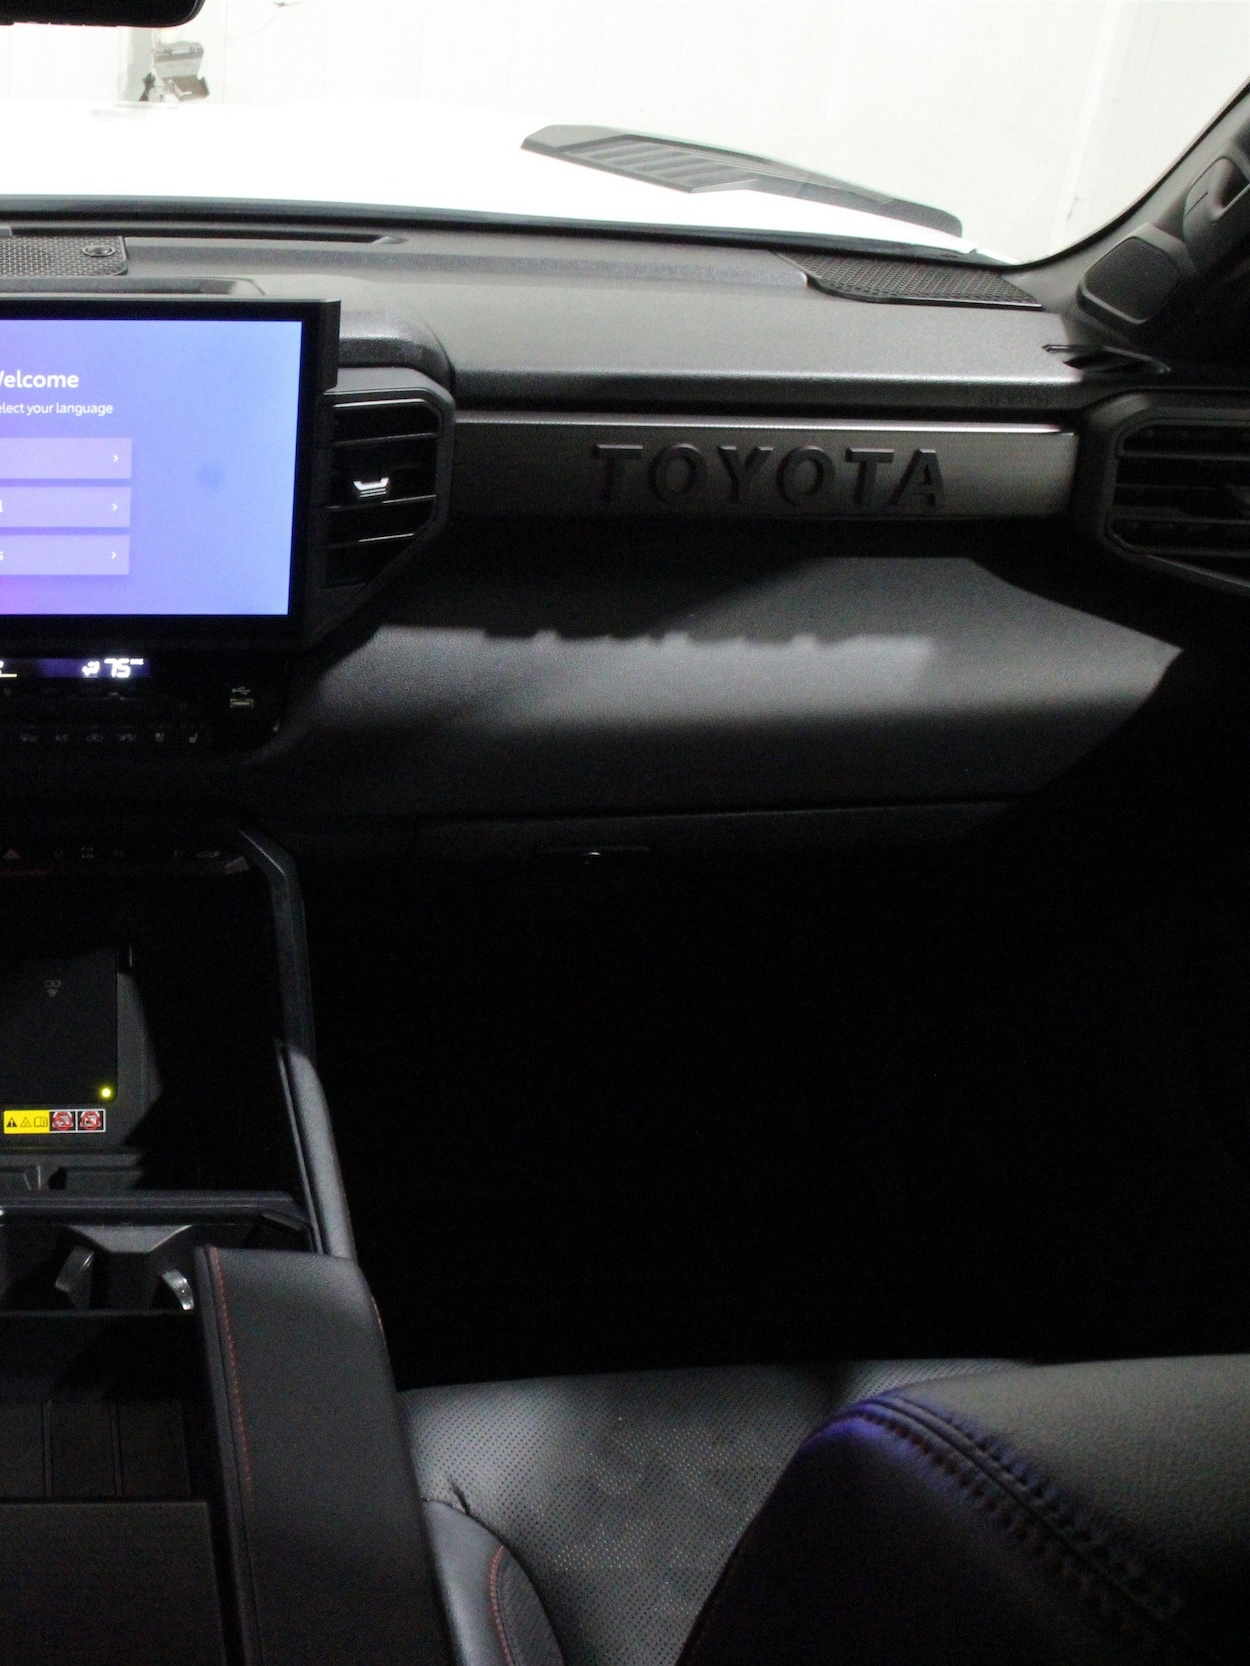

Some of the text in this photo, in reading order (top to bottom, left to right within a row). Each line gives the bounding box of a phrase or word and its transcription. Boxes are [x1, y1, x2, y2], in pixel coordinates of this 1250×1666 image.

[26, 404, 54, 416] your
[56, 402, 114, 417] language
[591, 443, 946, 506] TOYOTA
[103, 657, 132, 679] 75
